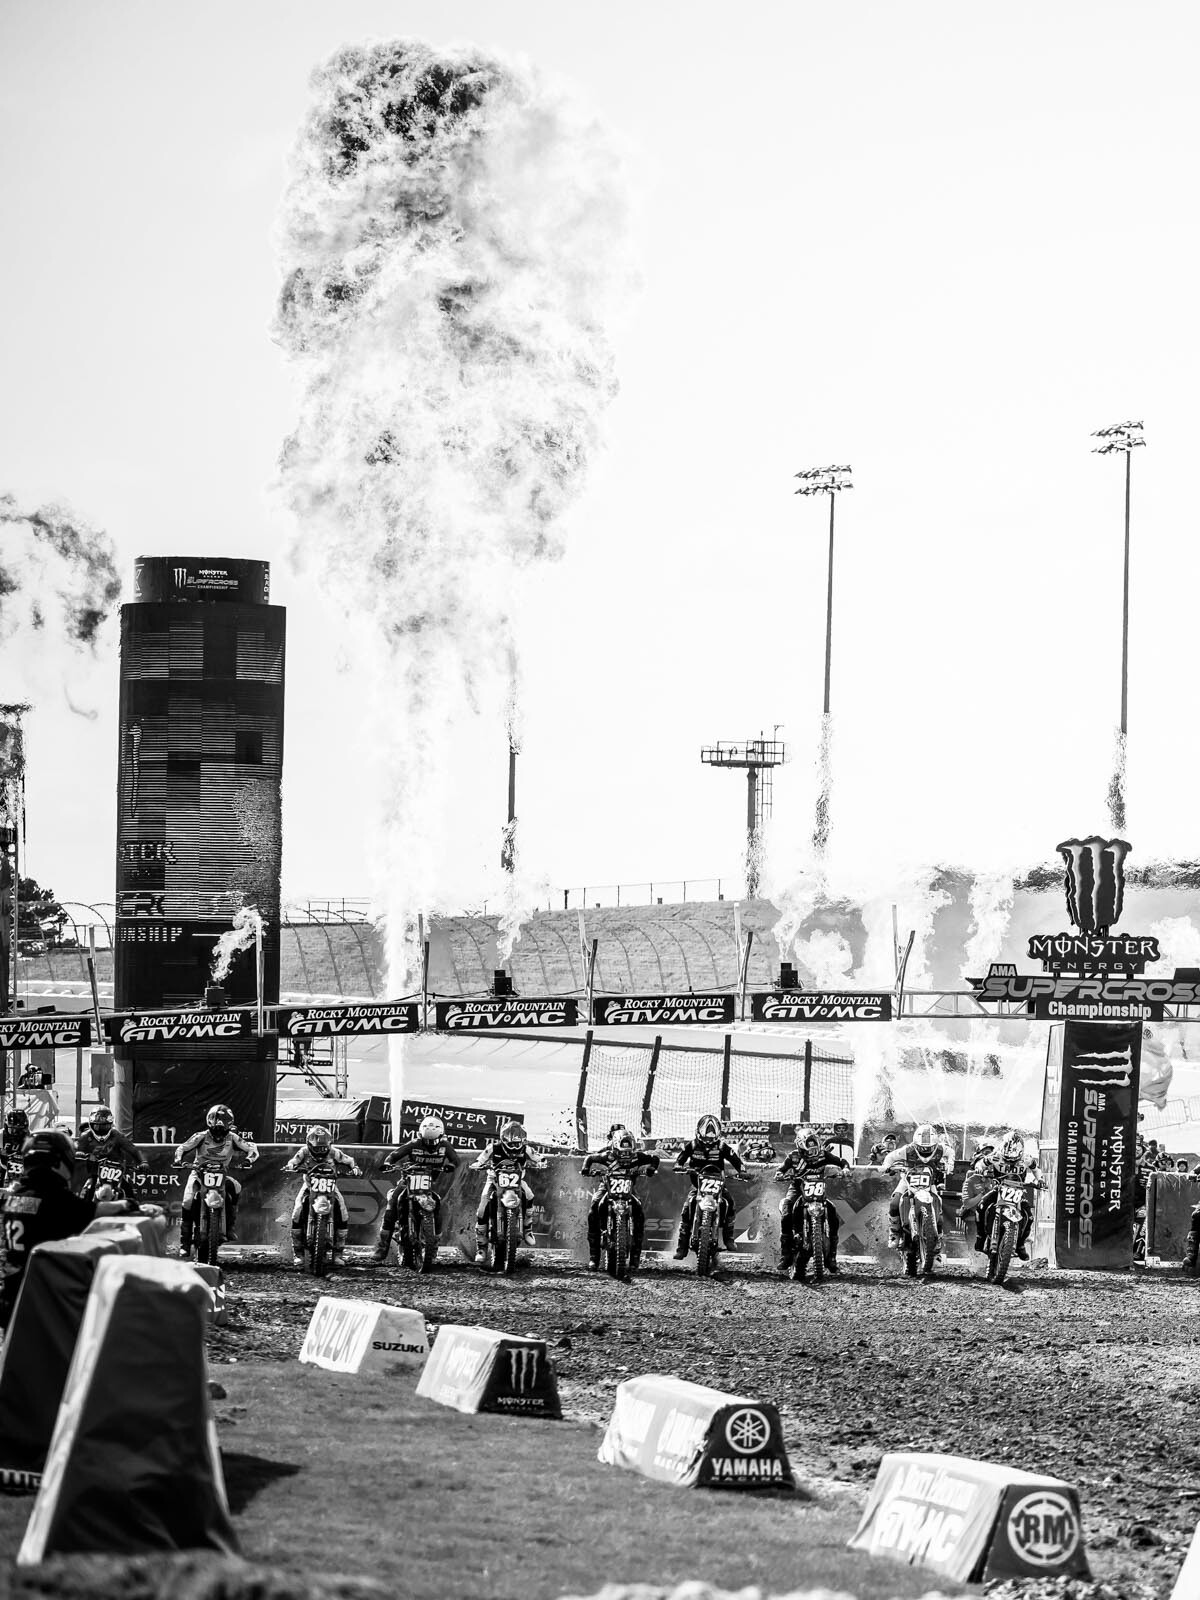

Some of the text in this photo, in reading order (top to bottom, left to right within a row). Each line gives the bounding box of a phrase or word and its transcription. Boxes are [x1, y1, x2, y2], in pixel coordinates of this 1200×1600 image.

[1032, 936, 1159, 959] MONSTER
[990, 965, 1016, 977] AMA
[1052, 962, 1138, 970] ENERGY
[623, 998, 725, 1009] ROCKY MOUNTAIN
[781, 994, 882, 1005] ROCKY MOUNTAIN
[306, 1006, 409, 1019] ROCKY MOUNTAIN
[464, 1002, 566, 1013] ROCKY MOUNTAIN
[1048, 1001, 1152, 1020] Championship
[18, 1021, 81, 1032] MOUNTAIN
[139, 1013, 242, 1027] ROCKY MOUNTAIN
[1098, 1092, 1106, 1112] AMA
[404, 1104, 488, 1126] MONSTER
[100, 1166, 122, 1181] 602
[1064, 1121, 1079, 1214] CHAMPIONSHIP
[1078, 1087, 1098, 1249] SUPERCROSS
[1100, 1139, 1108, 1199] ENERGY
[1108, 1125, 1125, 1213] MONSTER
[203, 1172, 224, 1187] 67
[310, 1177, 336, 1193] 285
[409, 1175, 431, 1190] 116
[498, 1173, 520, 1188] 62
[700, 1180, 723, 1193] 125
[909, 1174, 929, 1187] 50
[804, 1181, 825, 1196] 58
[1000, 1185, 1024, 1203] 128
[372, 1341, 424, 1354] SUZUKI
[497, 1396, 545, 1406] MONSTER
[711, 1458, 783, 1476] YAMAHA
[1023, 1514, 1065, 1545] RM
